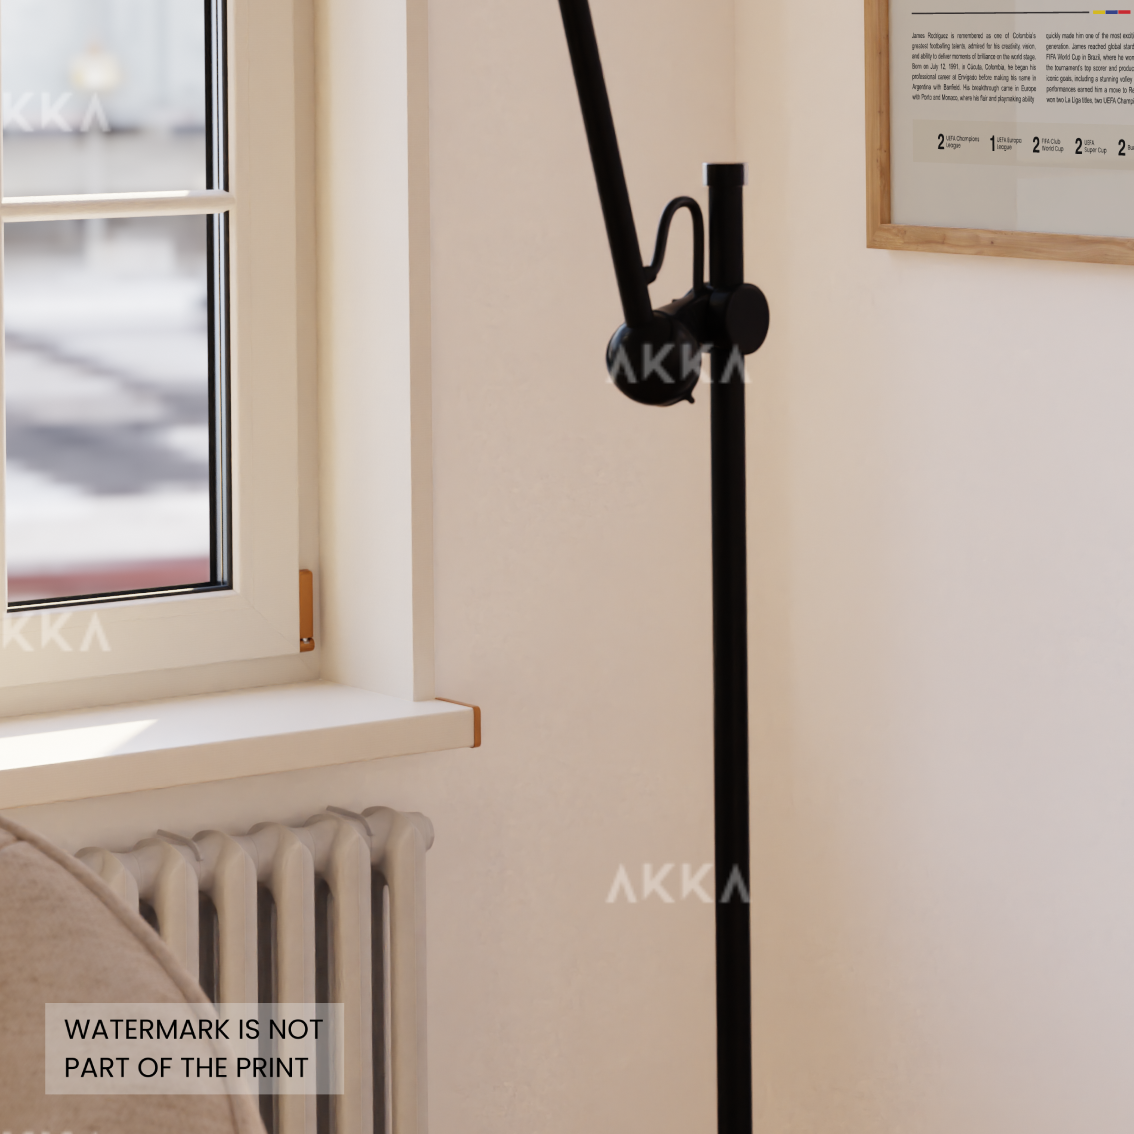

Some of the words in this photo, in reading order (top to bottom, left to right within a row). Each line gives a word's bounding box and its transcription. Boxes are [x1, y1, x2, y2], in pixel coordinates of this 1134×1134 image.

[938, 134, 944, 149] 2
[990, 135, 995, 151] 1
[1033, 137, 1040, 153] 2
[1075, 138, 1082, 154] 2
[1118, 139, 1126, 156] 2
